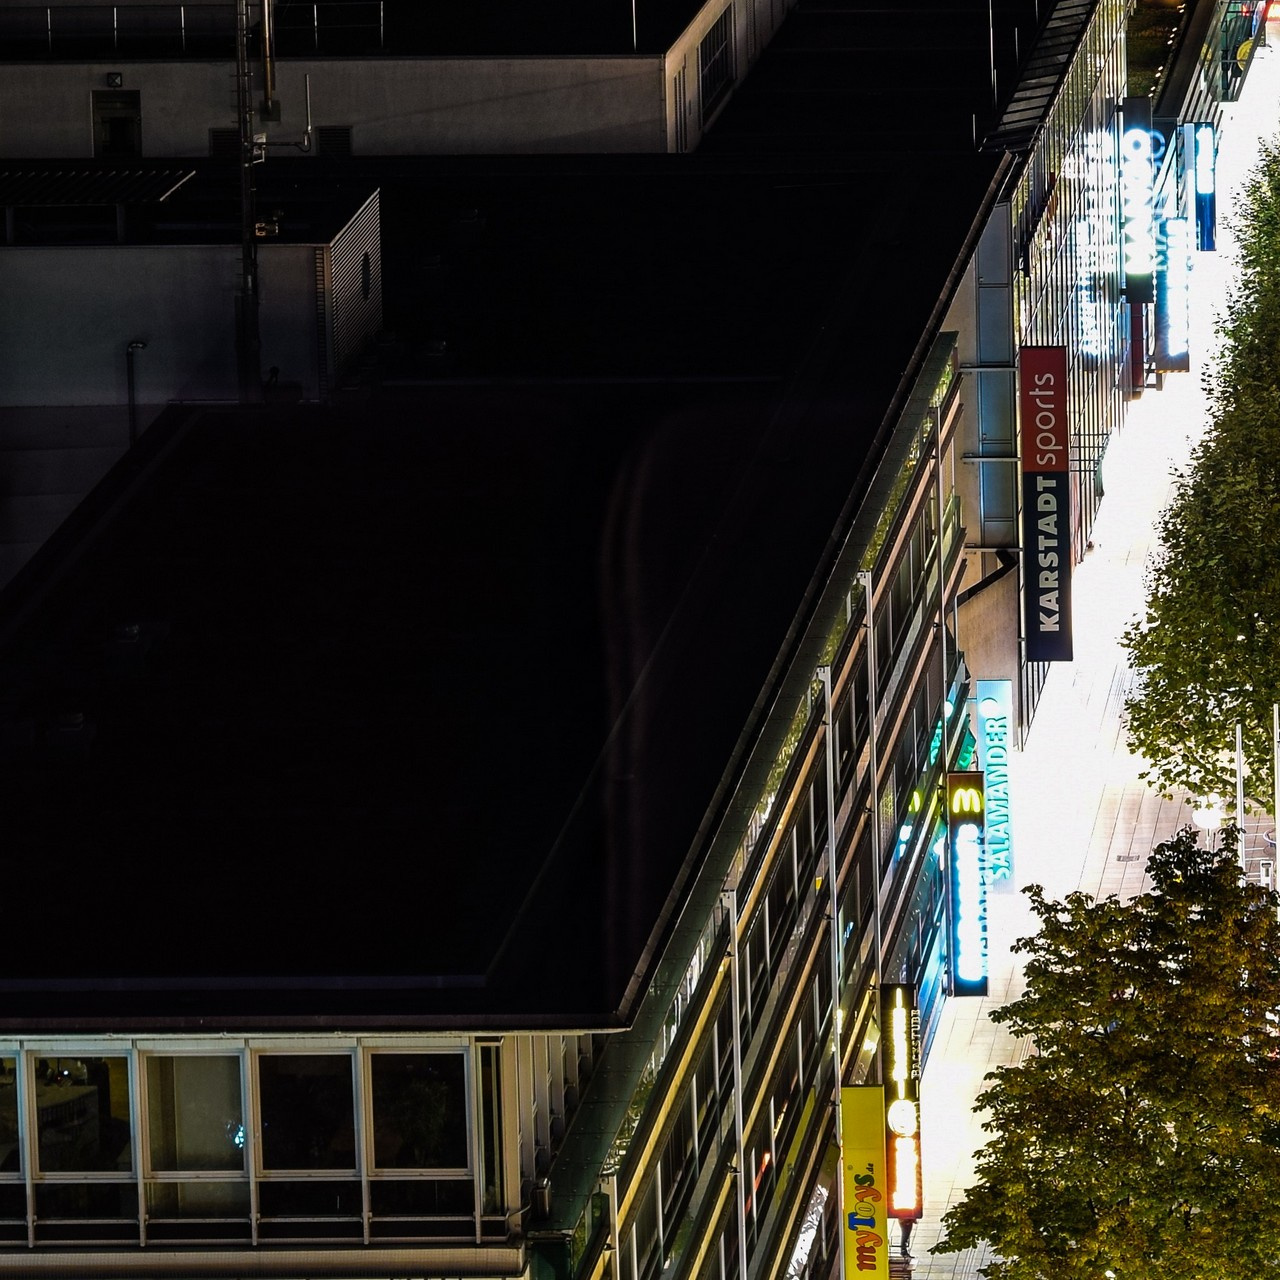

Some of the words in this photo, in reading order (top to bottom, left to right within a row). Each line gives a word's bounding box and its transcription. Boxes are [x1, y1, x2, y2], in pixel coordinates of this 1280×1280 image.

[1029, 373, 1063, 467] sports
[1037, 475, 1060, 632] KARSTADT
[985, 716, 1011, 881] SALAMANDER
[910, 1009, 921, 1079] BACKSTUBE
